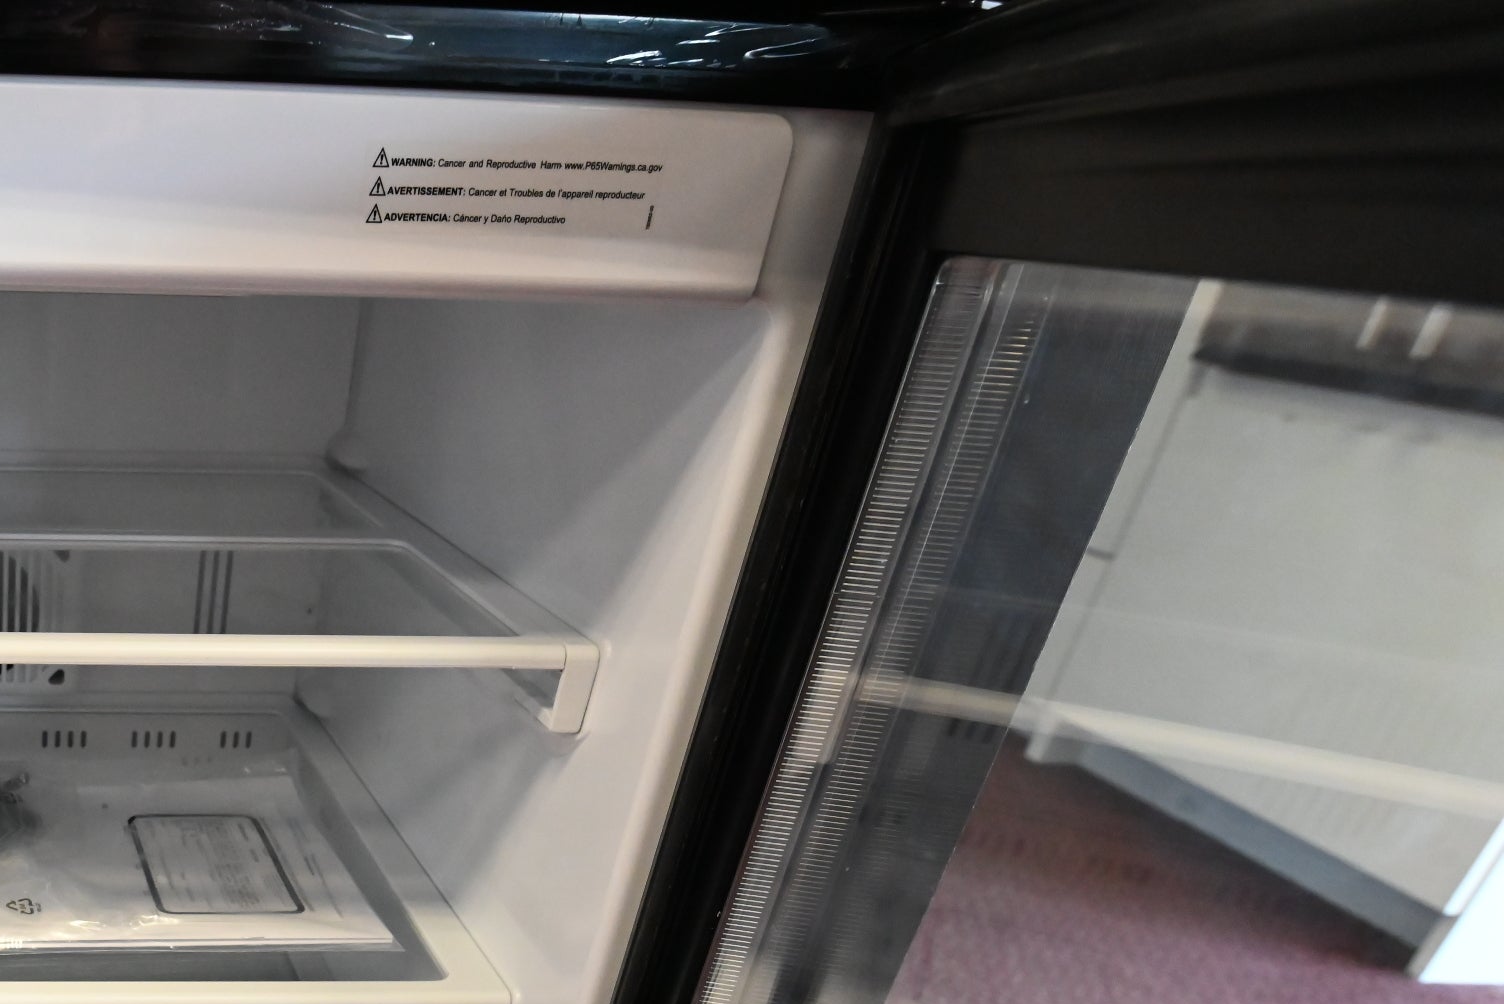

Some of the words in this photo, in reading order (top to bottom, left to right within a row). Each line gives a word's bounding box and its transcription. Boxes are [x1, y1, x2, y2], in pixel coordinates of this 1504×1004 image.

[391, 157, 436, 168] WARNING:
[438, 158, 466, 168] Cancer
[469, 159, 484, 168] and
[486, 159, 536, 170] Reproductive
[387, 186, 466, 196] AVERTISSEMENT:
[468, 187, 497, 197] Cancer
[499, 188, 508, 197] et
[510, 188, 544, 198] Troubles
[546, 189, 556, 198] de
[595, 191, 646, 201] reproducteur
[384, 212, 451, 222] ADVERTENCIA:
[453, 213, 482, 223] Cáncer
[483, 216, 489, 225] y
[514, 214, 566, 225] Reproductivo
